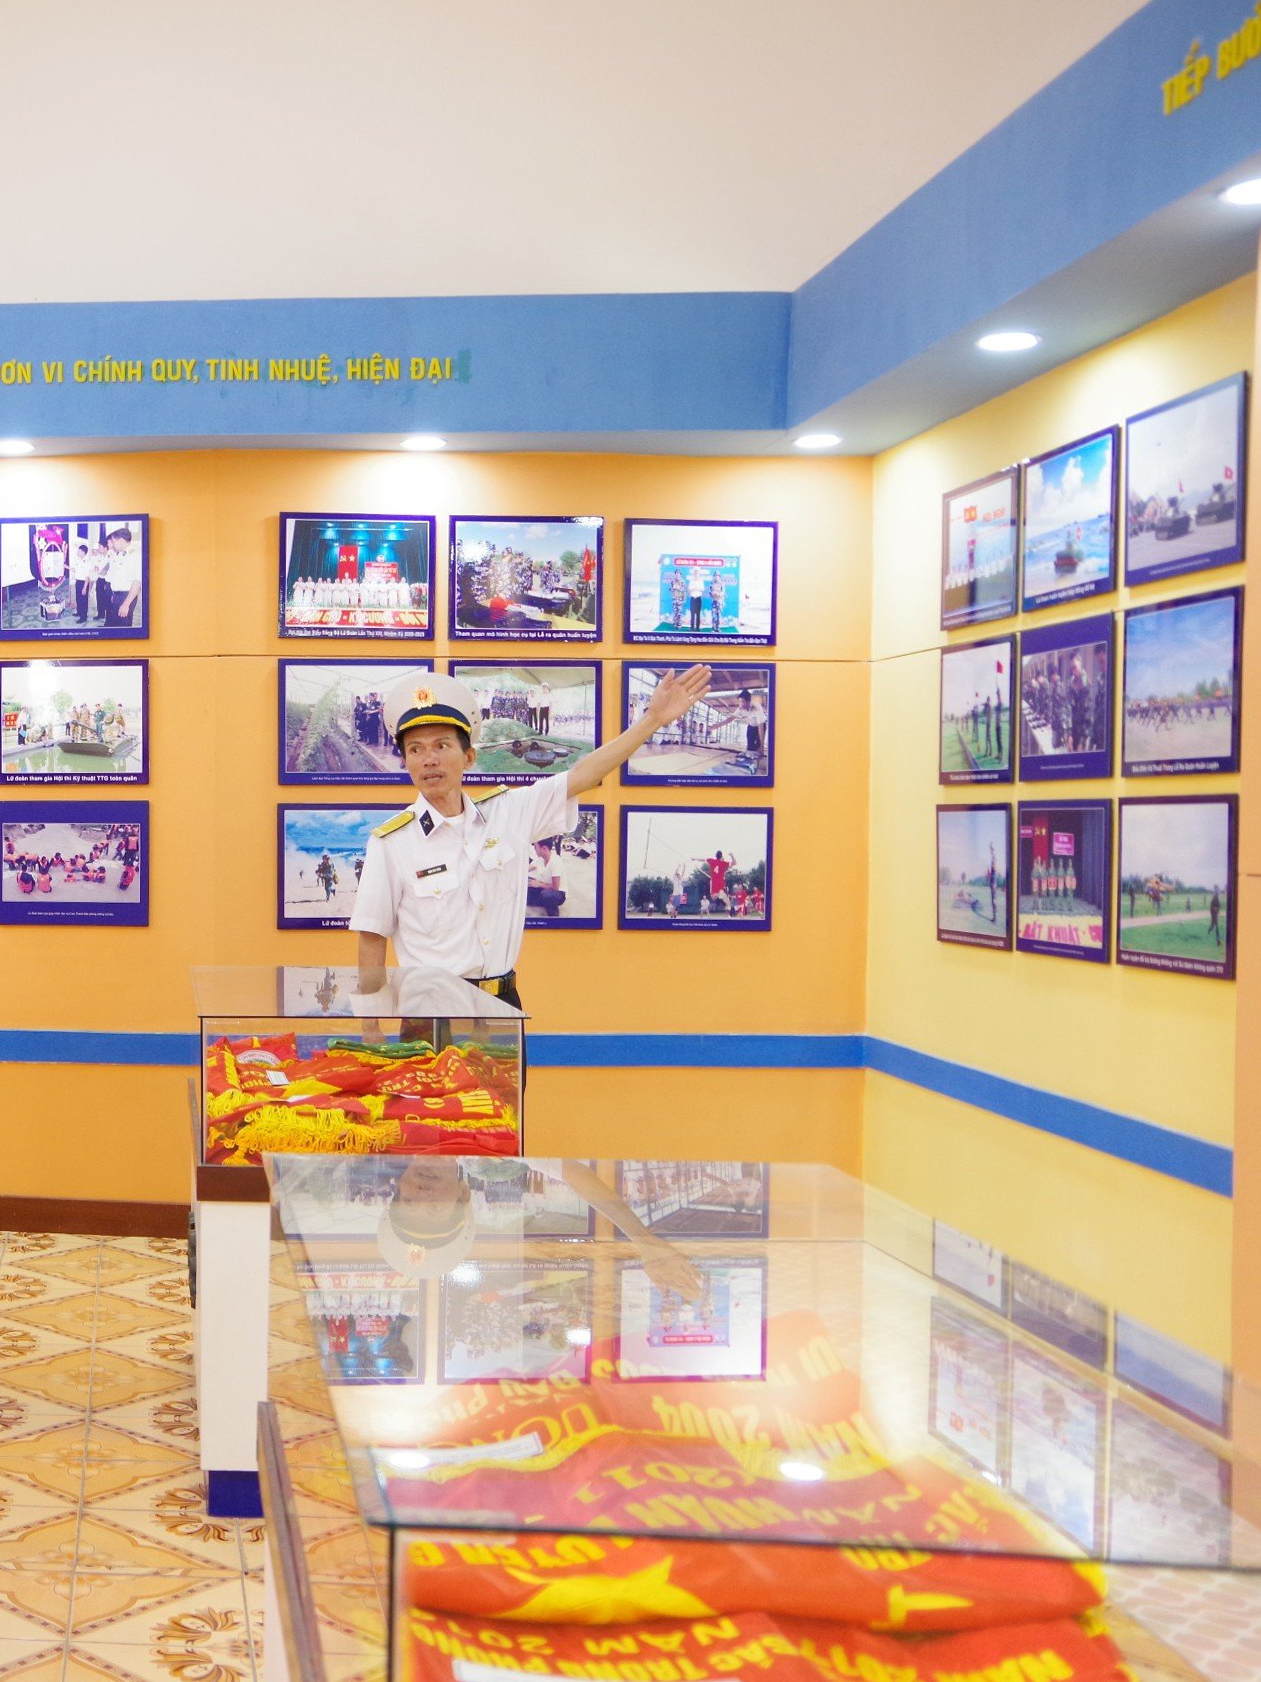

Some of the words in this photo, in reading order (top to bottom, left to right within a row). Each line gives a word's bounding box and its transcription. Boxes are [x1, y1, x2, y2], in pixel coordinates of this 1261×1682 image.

[1161, 38, 1211, 115] TIẾP
[73, 355, 142, 383] CHÍNH
[151, 358, 199, 384] QUY,
[206, 358, 259, 382] TINH
[268, 354, 338, 385] NHUỆ,
[346, 352, 400, 385] HIỆN
[409, 357, 452, 384] ĐẠI
